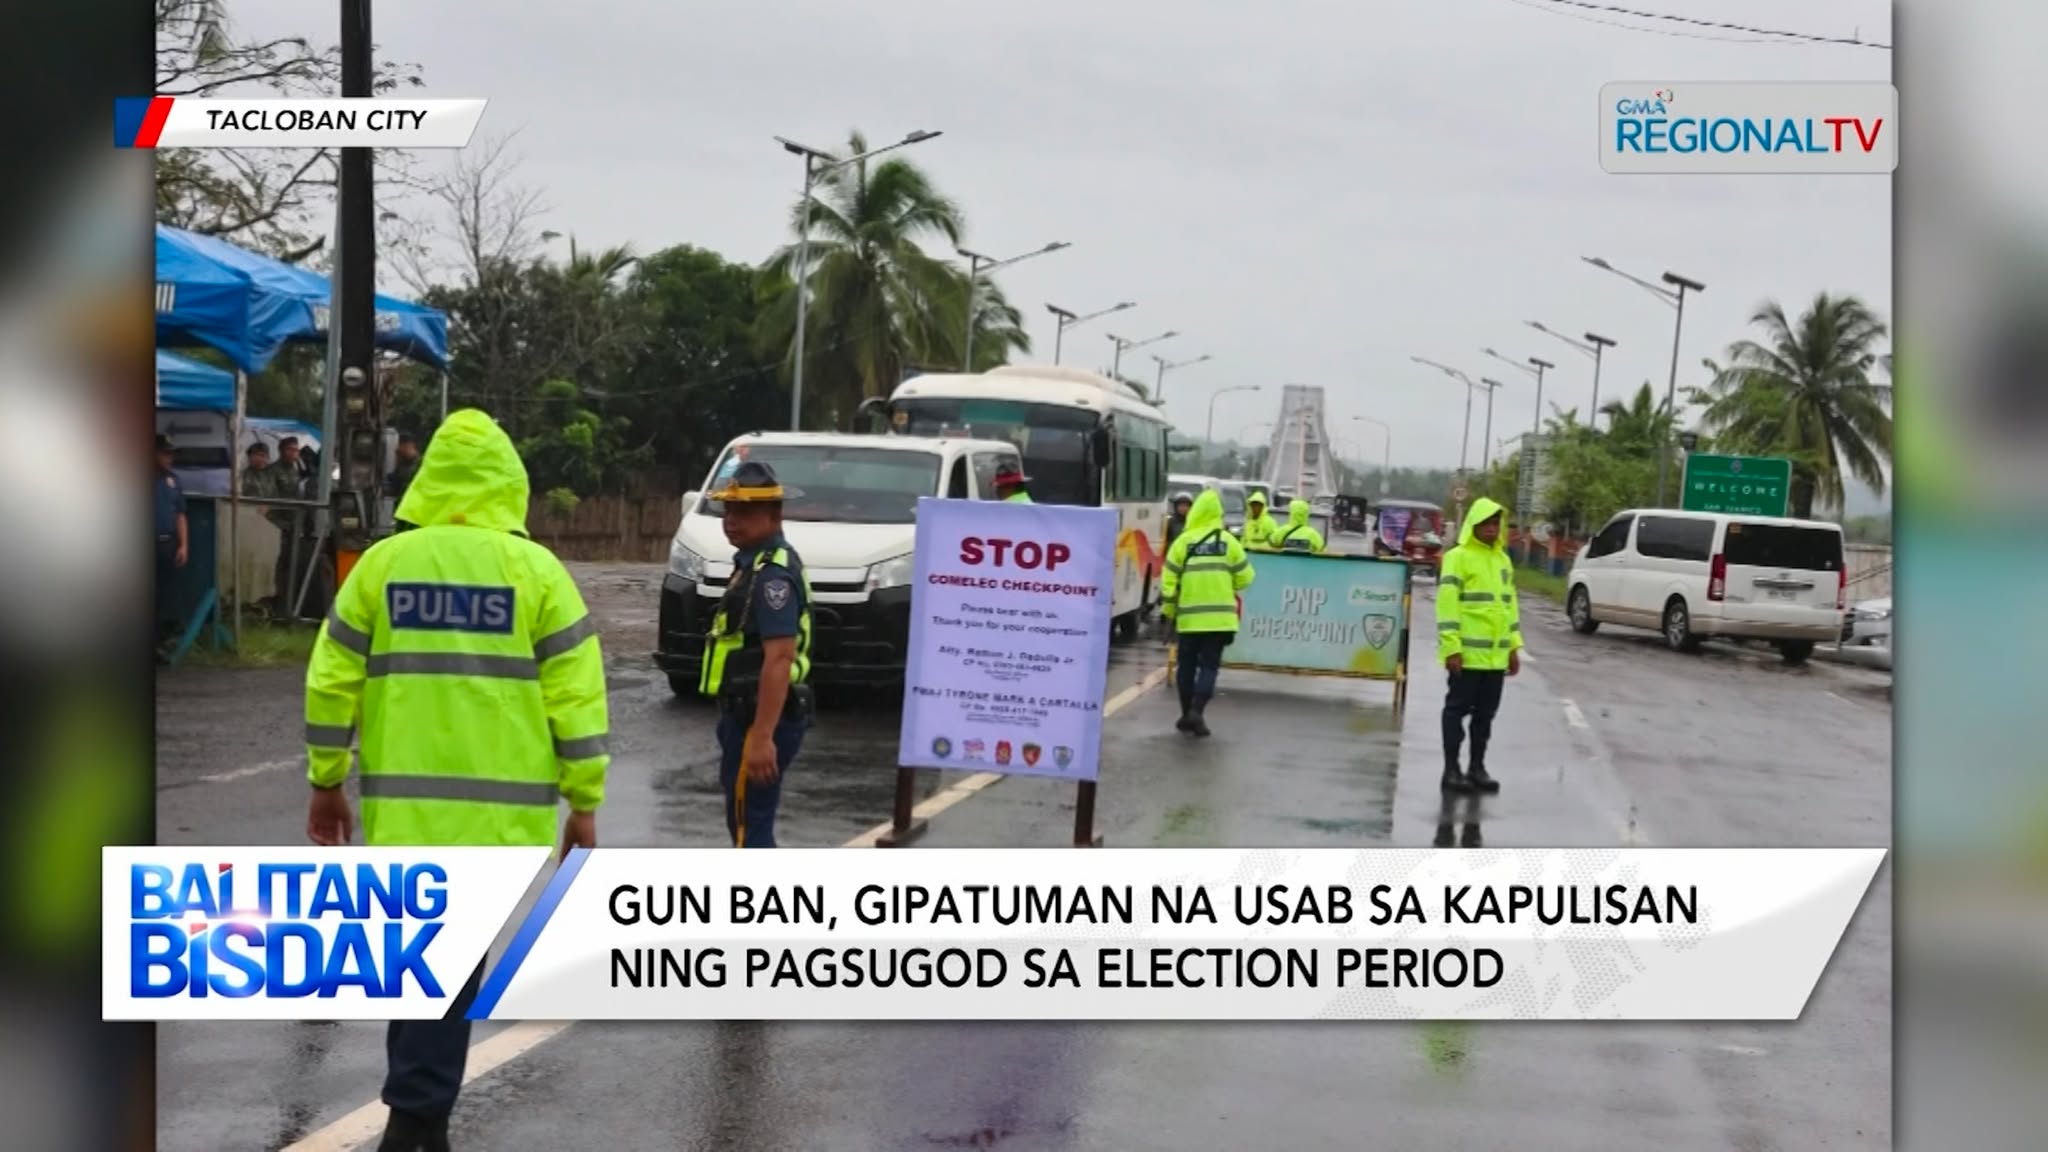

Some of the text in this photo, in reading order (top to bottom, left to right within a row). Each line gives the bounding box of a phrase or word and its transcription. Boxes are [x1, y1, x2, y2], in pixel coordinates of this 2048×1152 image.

[1694, 482, 1778, 497] WELCOME
[959, 536, 1071, 572] STOP
[928, 574, 1099, 598] COMELEC CHECKPOINT
[391, 589, 507, 627] PULIS
[960, 602, 994, 615] Please
[1021, 609, 1043, 619] with
[1282, 585, 1328, 616] PNP
[932, 615, 962, 626] Thank
[964, 620, 984, 629] you
[985, 619, 1000, 630] for
[1002, 623, 1026, 632] your
[1250, 616, 1357, 645] CHECKPOINT
